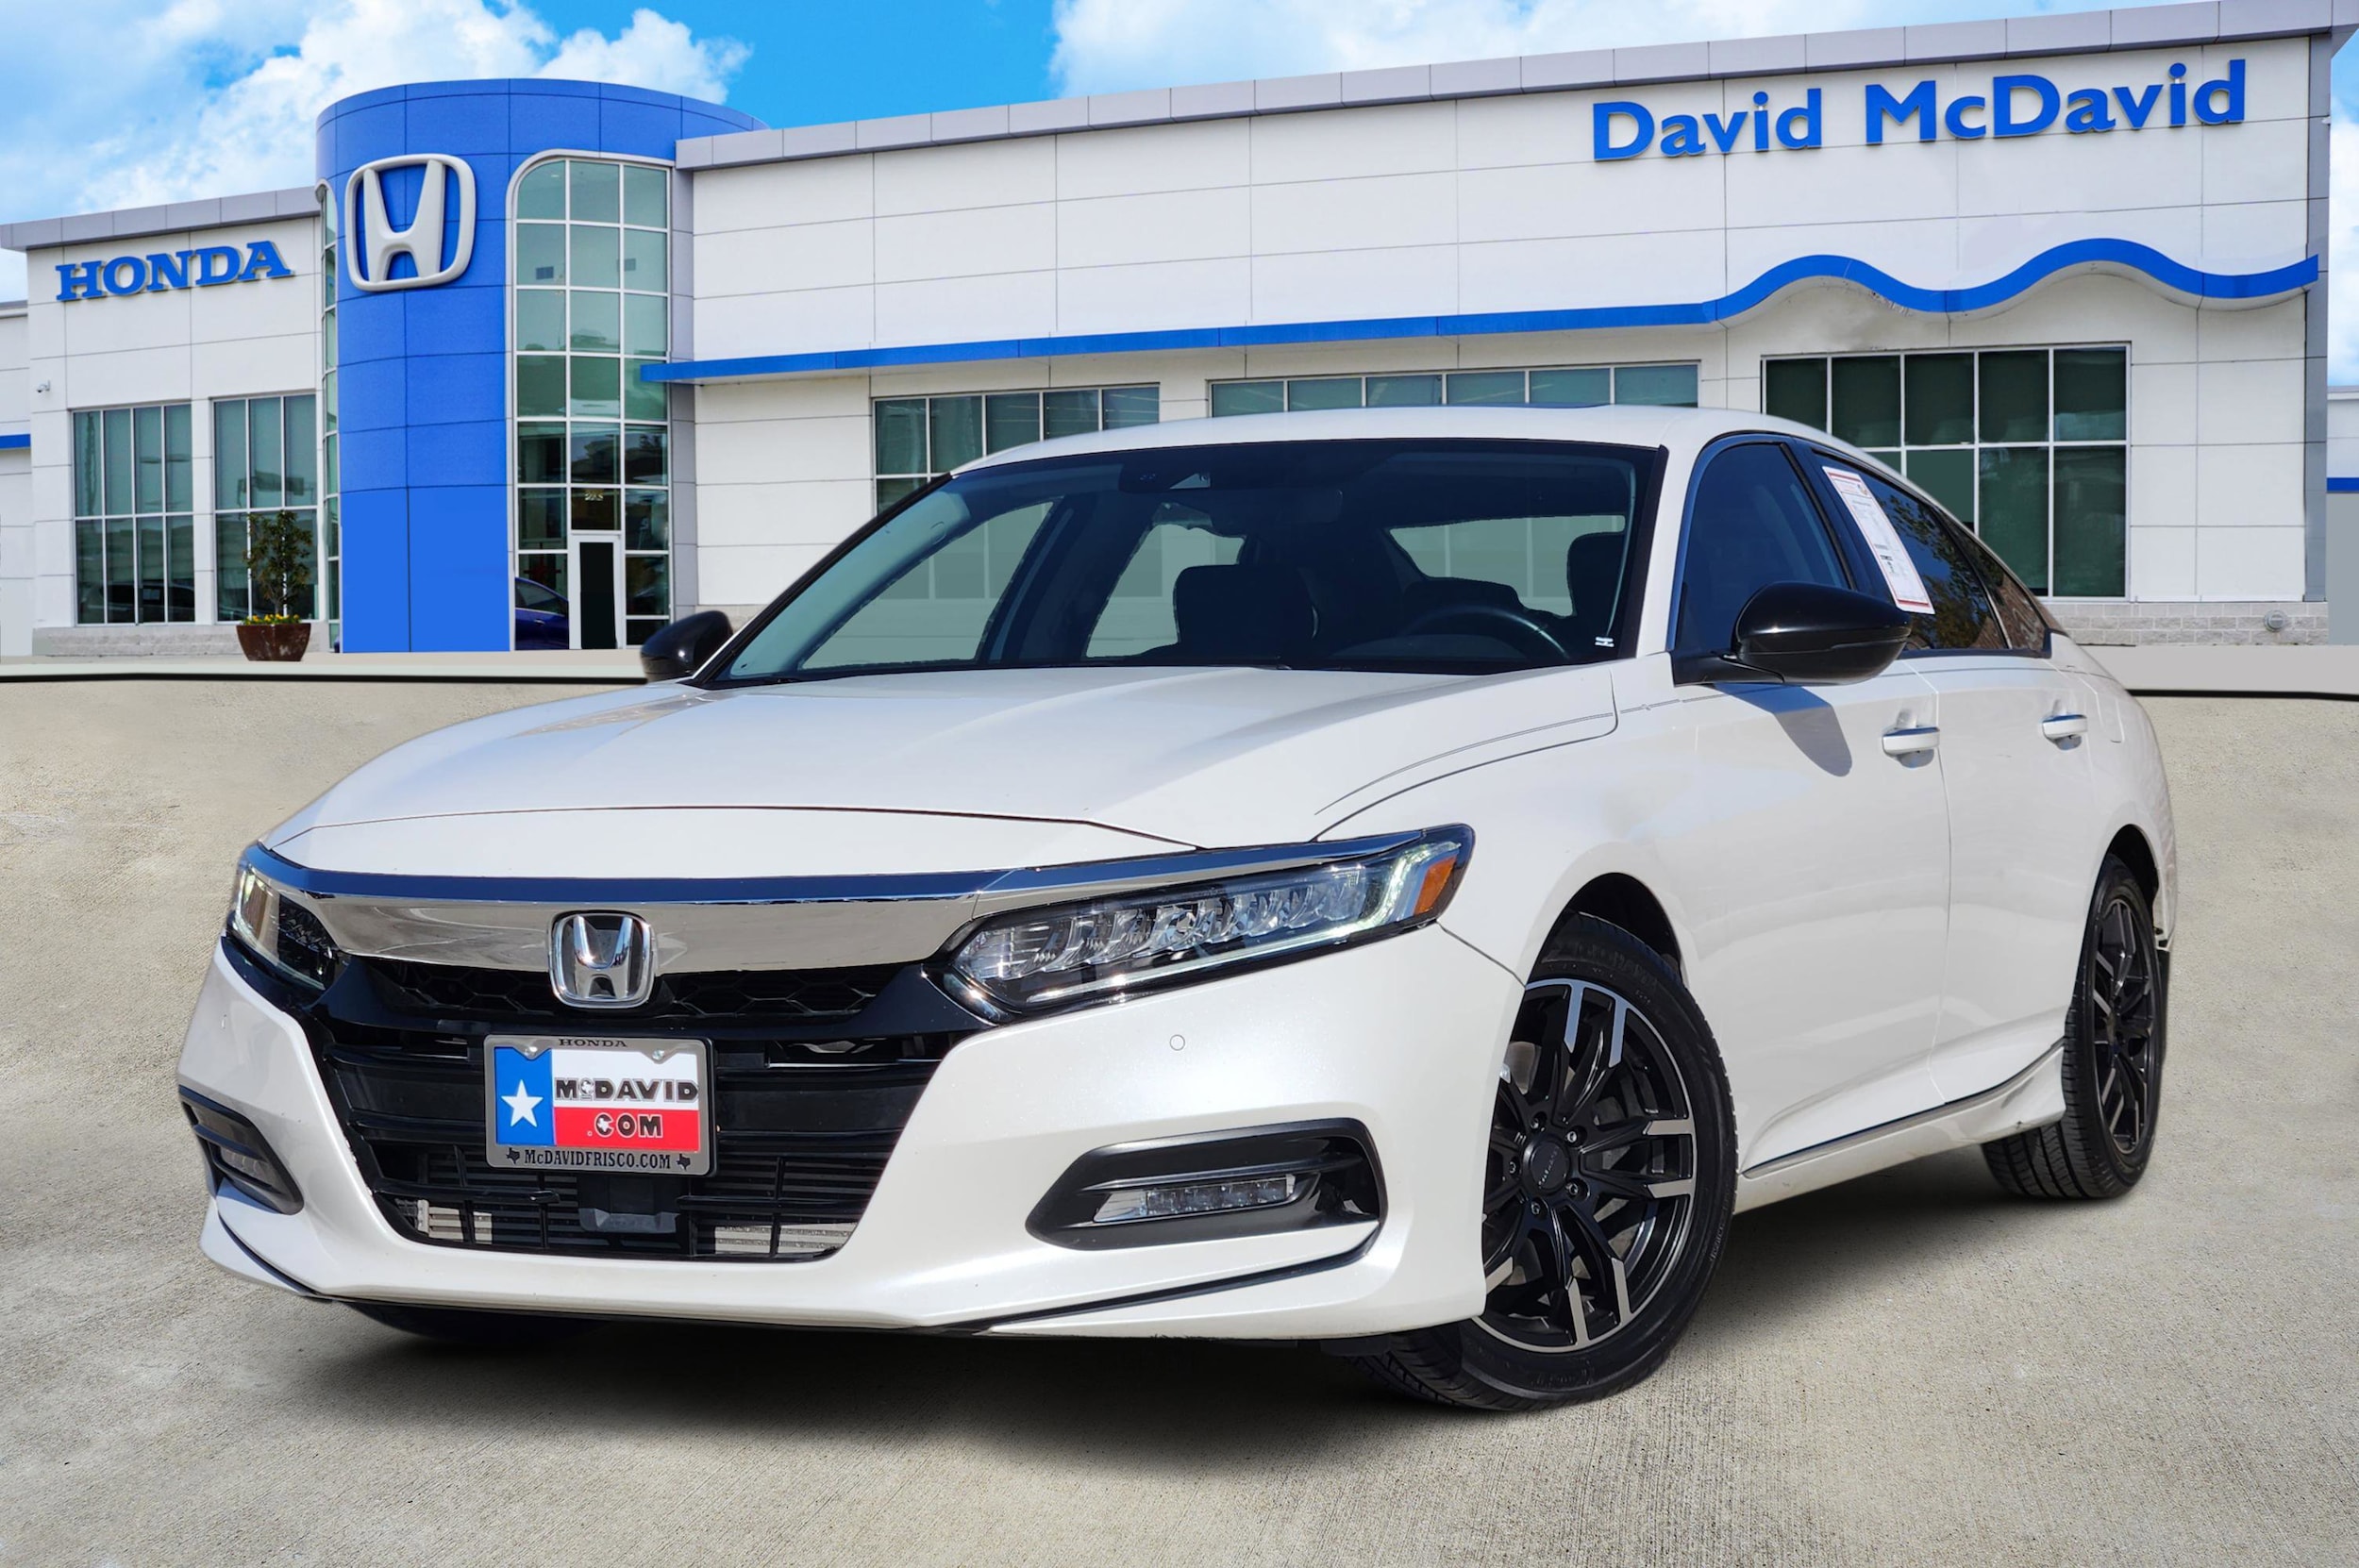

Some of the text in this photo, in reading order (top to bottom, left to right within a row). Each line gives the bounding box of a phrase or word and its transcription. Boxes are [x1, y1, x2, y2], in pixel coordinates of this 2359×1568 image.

[1593, 58, 2246, 161] David McDavid
[55, 240, 294, 302] HONDA
[559, 1038, 627, 1047] HONDA
[524, 1149, 671, 1170] McDAVIDFRISCO.COM
